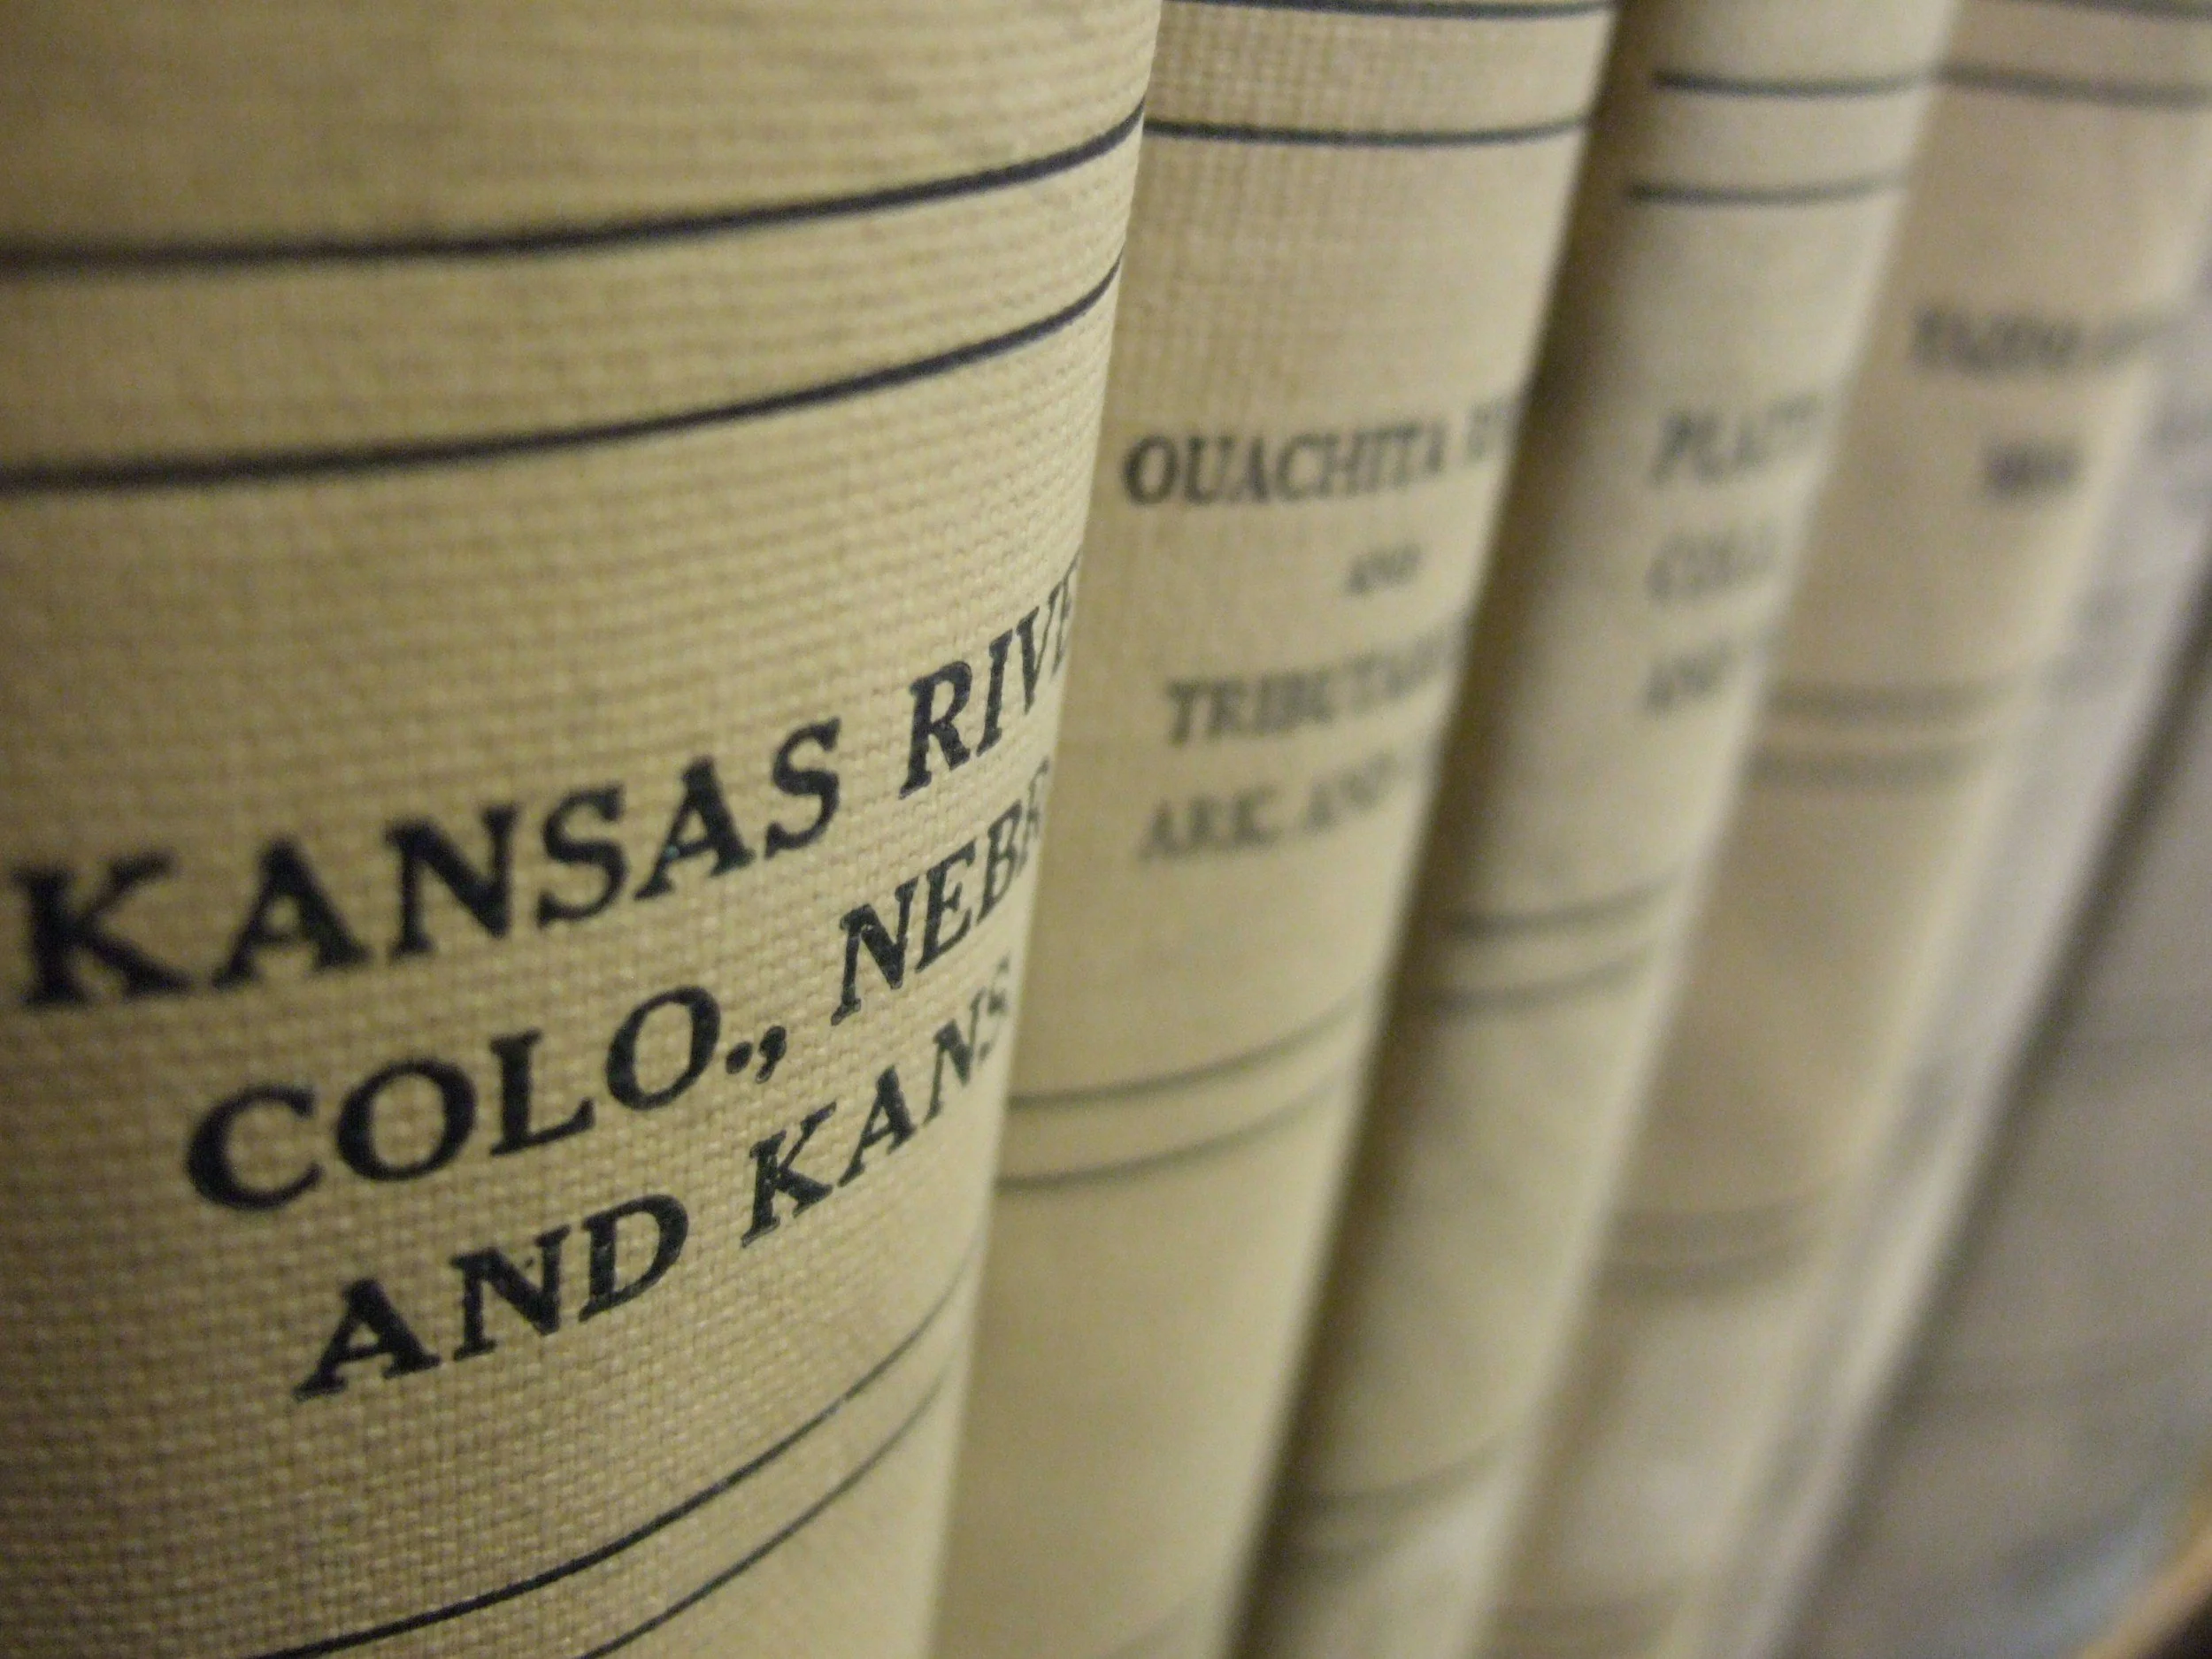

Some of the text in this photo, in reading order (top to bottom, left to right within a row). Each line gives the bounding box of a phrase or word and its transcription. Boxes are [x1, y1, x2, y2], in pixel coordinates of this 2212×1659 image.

[1122, 419, 1448, 506] OUACHITA
[12, 717, 841, 1007] KANSAS
[187, 985, 787, 1210] COLO.,
[292, 1192, 690, 1402] AND
